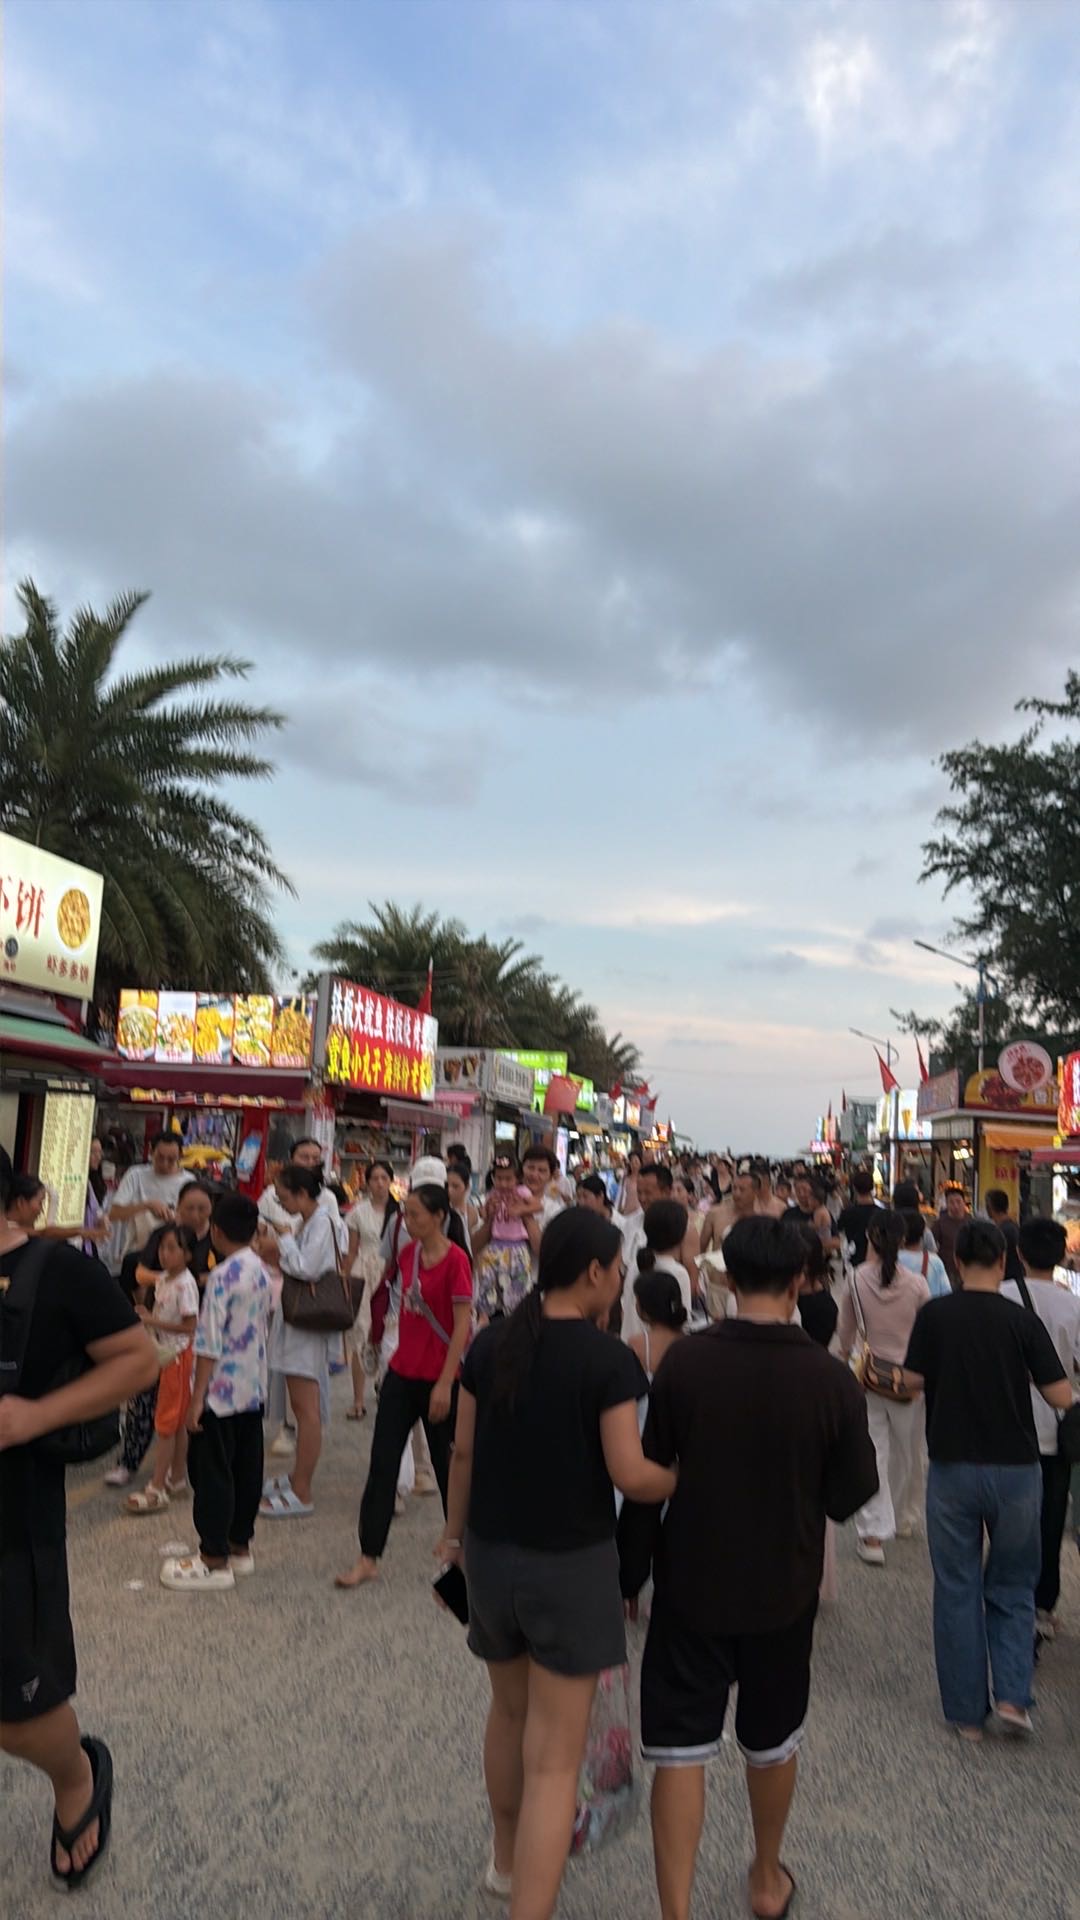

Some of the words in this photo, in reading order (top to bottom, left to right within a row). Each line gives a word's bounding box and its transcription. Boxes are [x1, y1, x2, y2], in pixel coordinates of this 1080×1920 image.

[331, 981, 384, 1040] 铁板大鱿鱼
[327, 1031, 382, 1089] 章鱼小丸子
